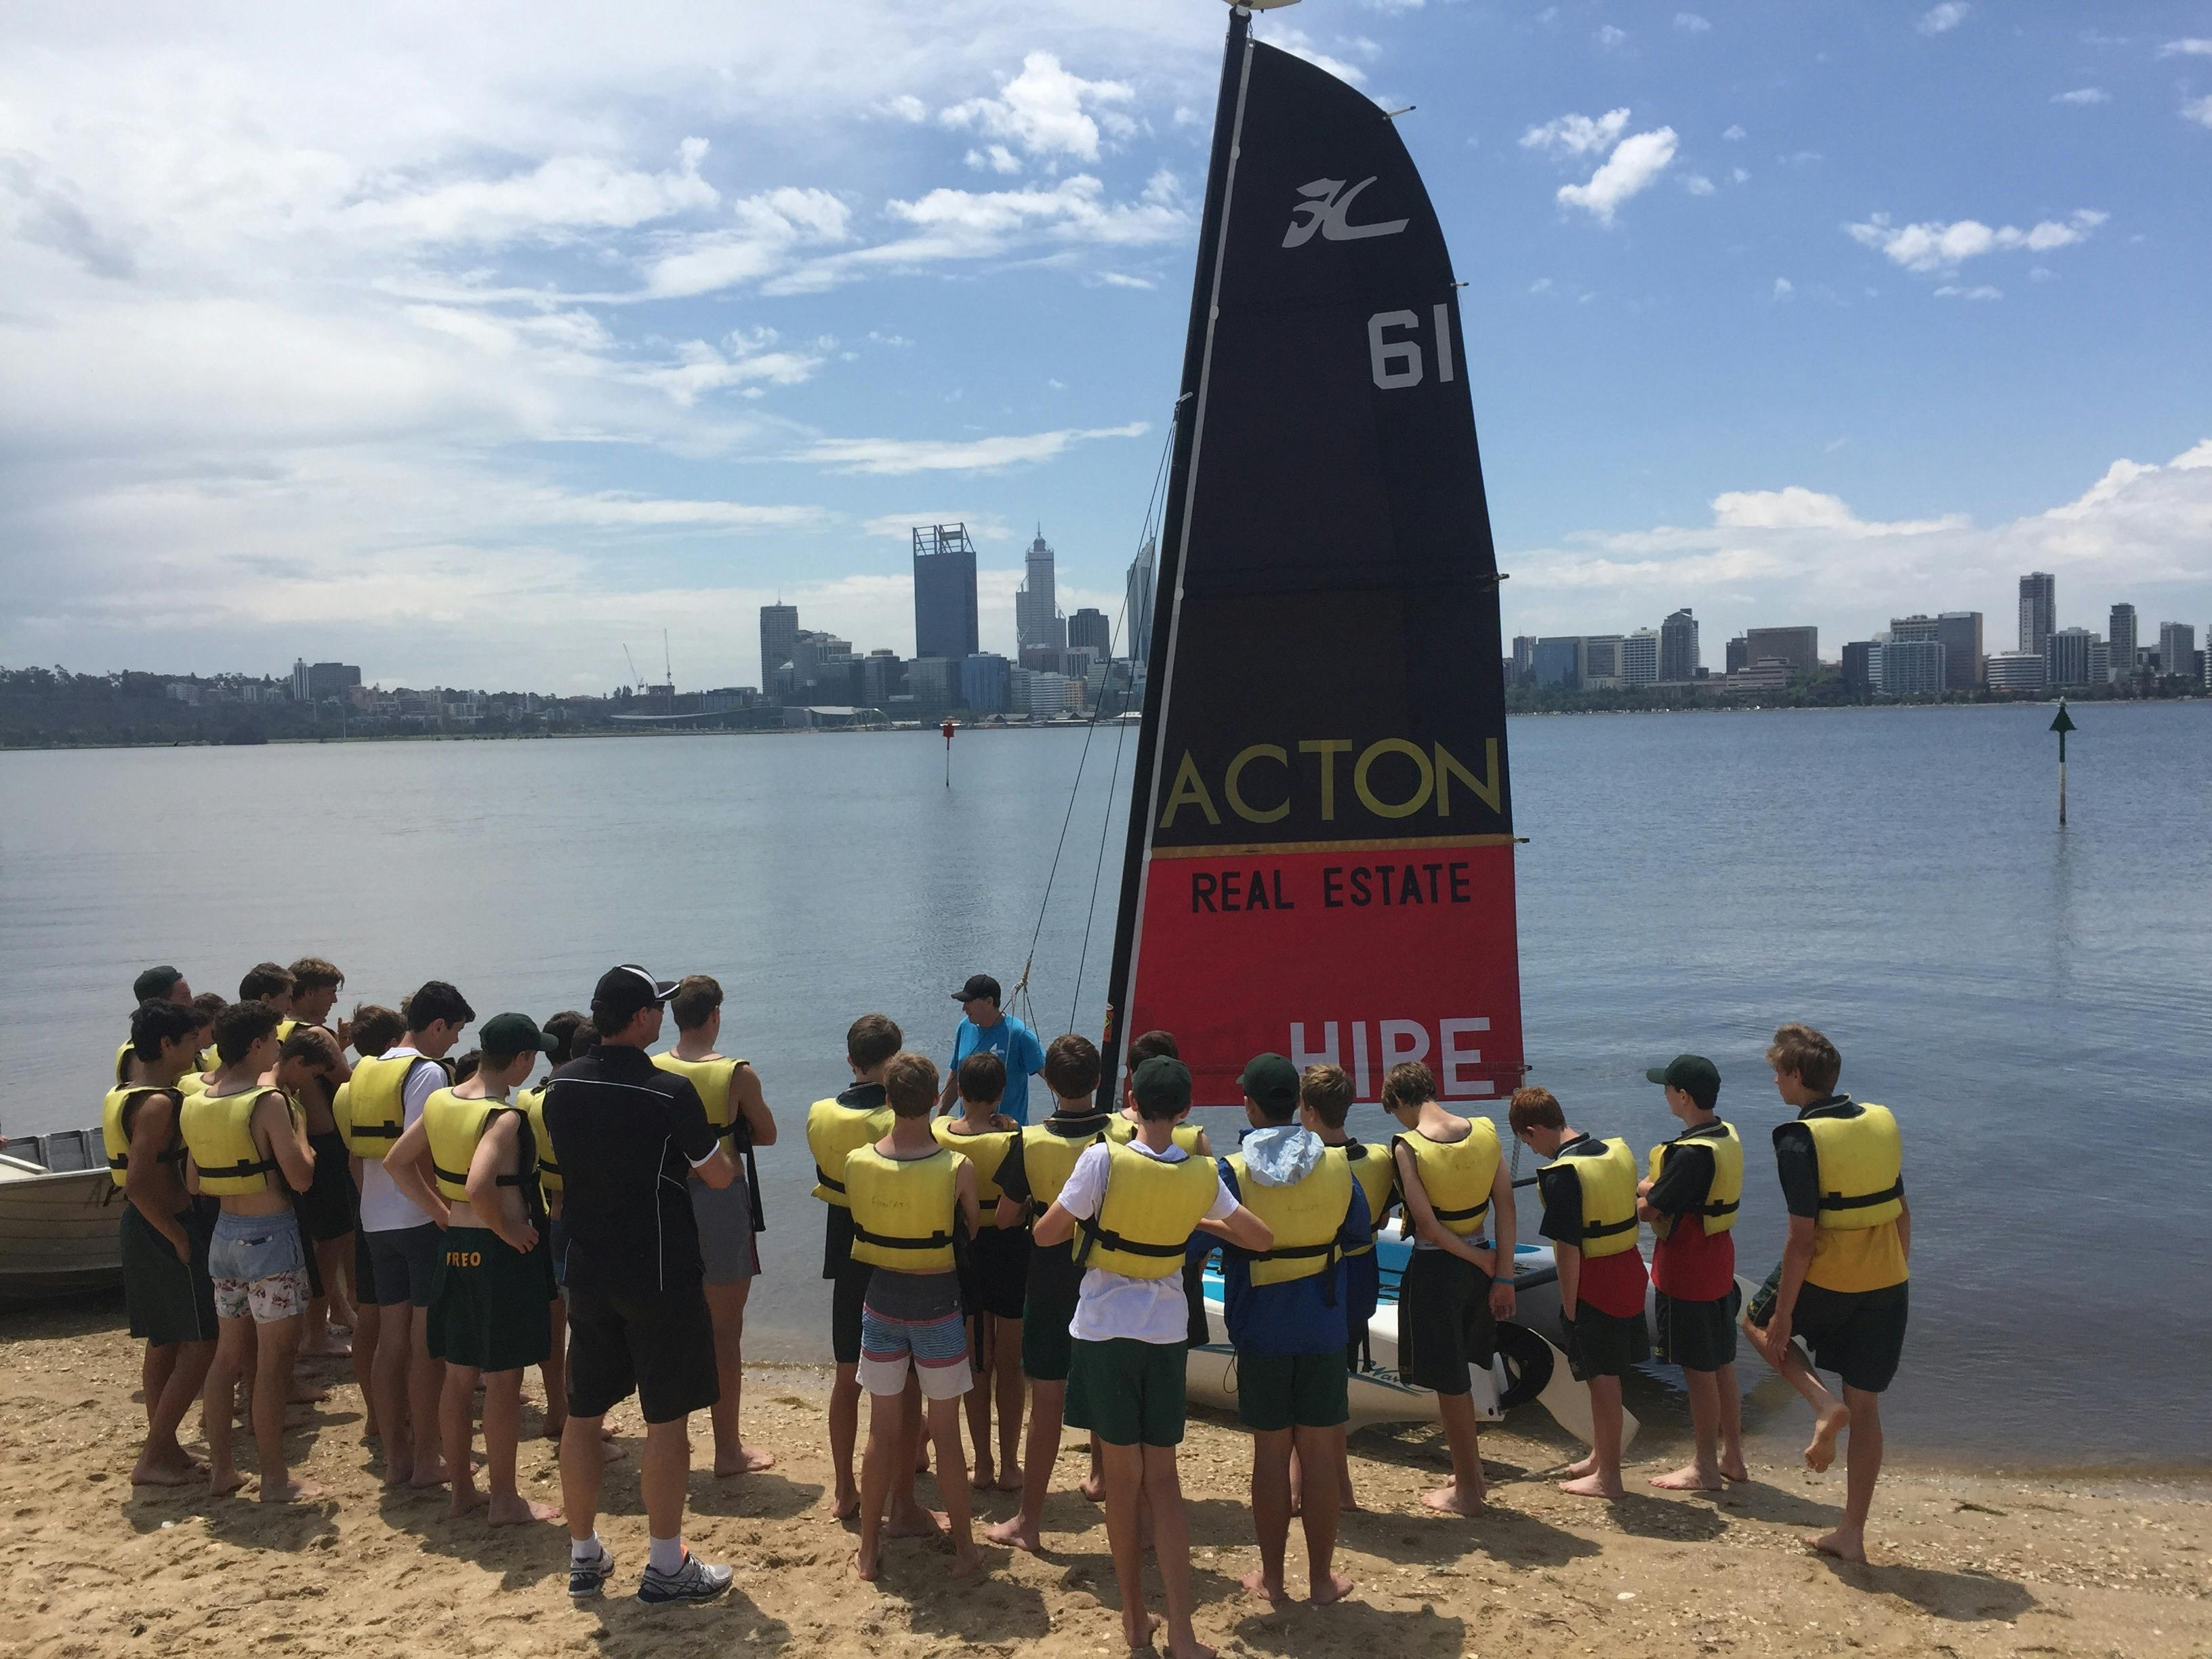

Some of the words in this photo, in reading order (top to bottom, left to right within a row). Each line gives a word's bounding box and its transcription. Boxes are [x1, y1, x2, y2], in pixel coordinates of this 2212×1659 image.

[1368, 304, 1454, 389] 61
[1159, 737, 1501, 828] ACTON
[1191, 869, 1294, 913] REAL
[1324, 862, 1471, 907] ESTATE
[1290, 1017, 1495, 1098] HIRE
